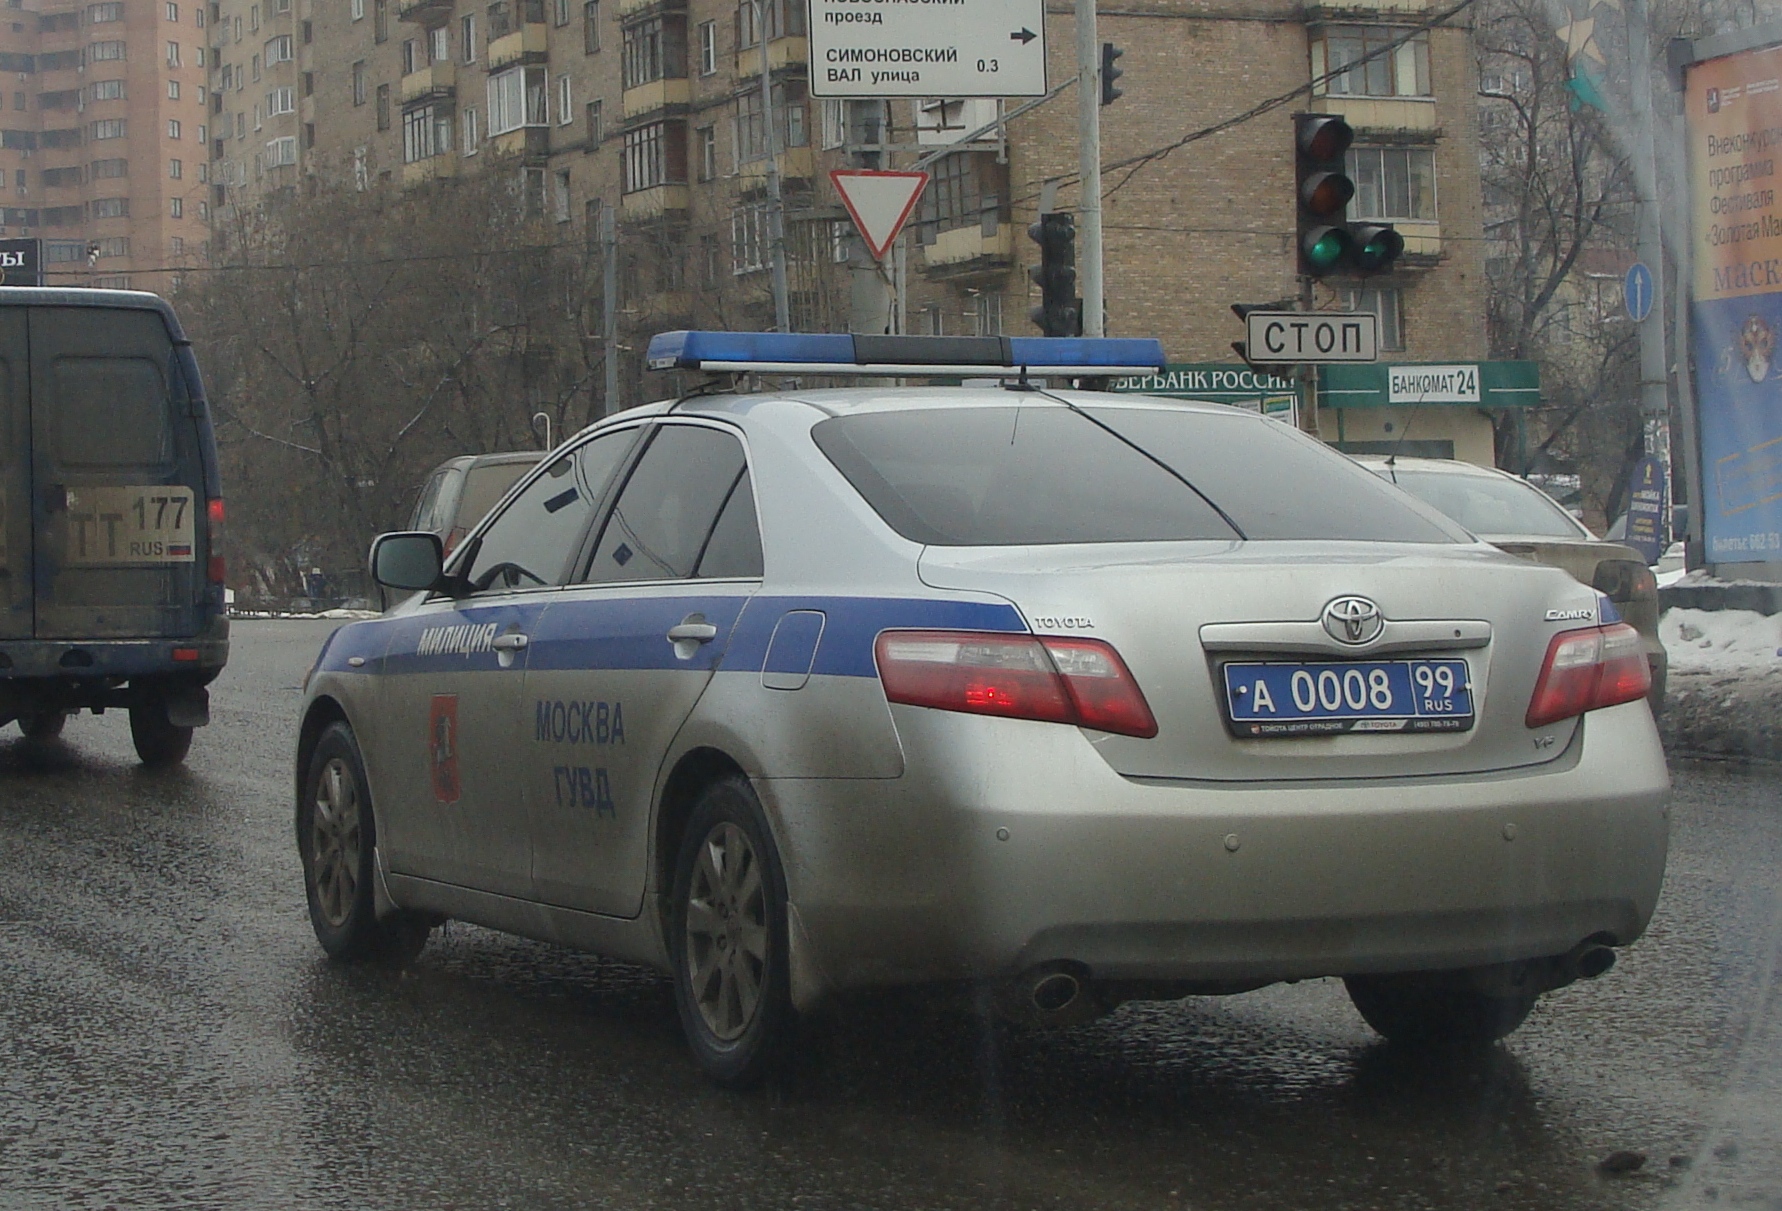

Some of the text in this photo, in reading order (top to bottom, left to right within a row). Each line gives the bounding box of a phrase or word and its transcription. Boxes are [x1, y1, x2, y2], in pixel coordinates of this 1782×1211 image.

[825, 12, 882, 25] проезд
[826, 46, 958, 63] СИМОНОВСКИЙ
[976, 59, 999, 73] 0.3
[827, 68, 920, 84] ВАЛ улица
[1264, 322, 1361, 353] СТОП
[1110, 371, 1208, 389] БЕРБАНК
[1392, 370, 1476, 395] БАНКОМАТ 24
[132, 497, 188, 530] 177
[129, 541, 164, 556] RUS
[1035, 616, 1095, 629] TOYOTA
[417, 622, 498, 659] МИЛИЦИЯ
[1291, 669, 1393, 712] 0008
[1415, 665, 1454, 698] 99
[1425, 700, 1454, 712] RUS
[536, 700, 626, 745] МОСКВА
[554, 765, 616, 820] ГУВД
